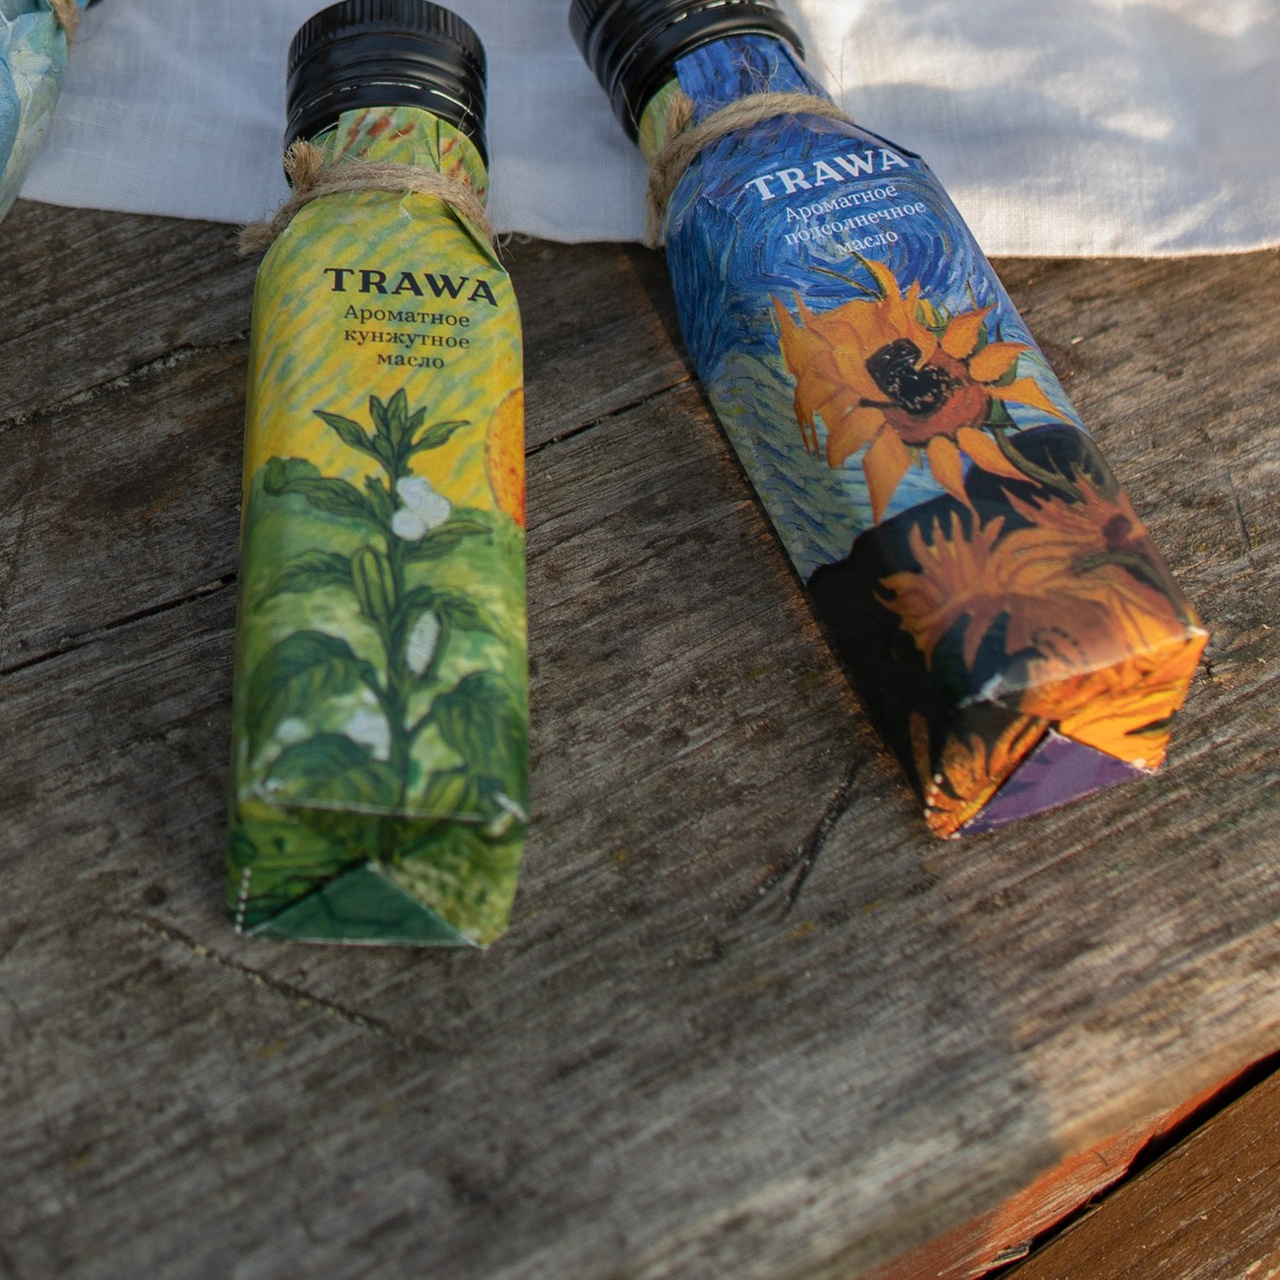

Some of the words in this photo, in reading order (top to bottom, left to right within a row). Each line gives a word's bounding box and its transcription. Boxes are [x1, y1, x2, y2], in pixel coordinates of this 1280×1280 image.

[745, 148, 910, 201] TRAWA
[785, 184, 898, 223] Ароматное
[784, 201, 927, 246] подсолнечное
[835, 230, 899, 255] масло
[323, 267, 498, 308] TRAWA
[343, 305, 470, 327] Ароматное
[344, 329, 470, 350] кунжутное
[377, 353, 445, 370] масло
